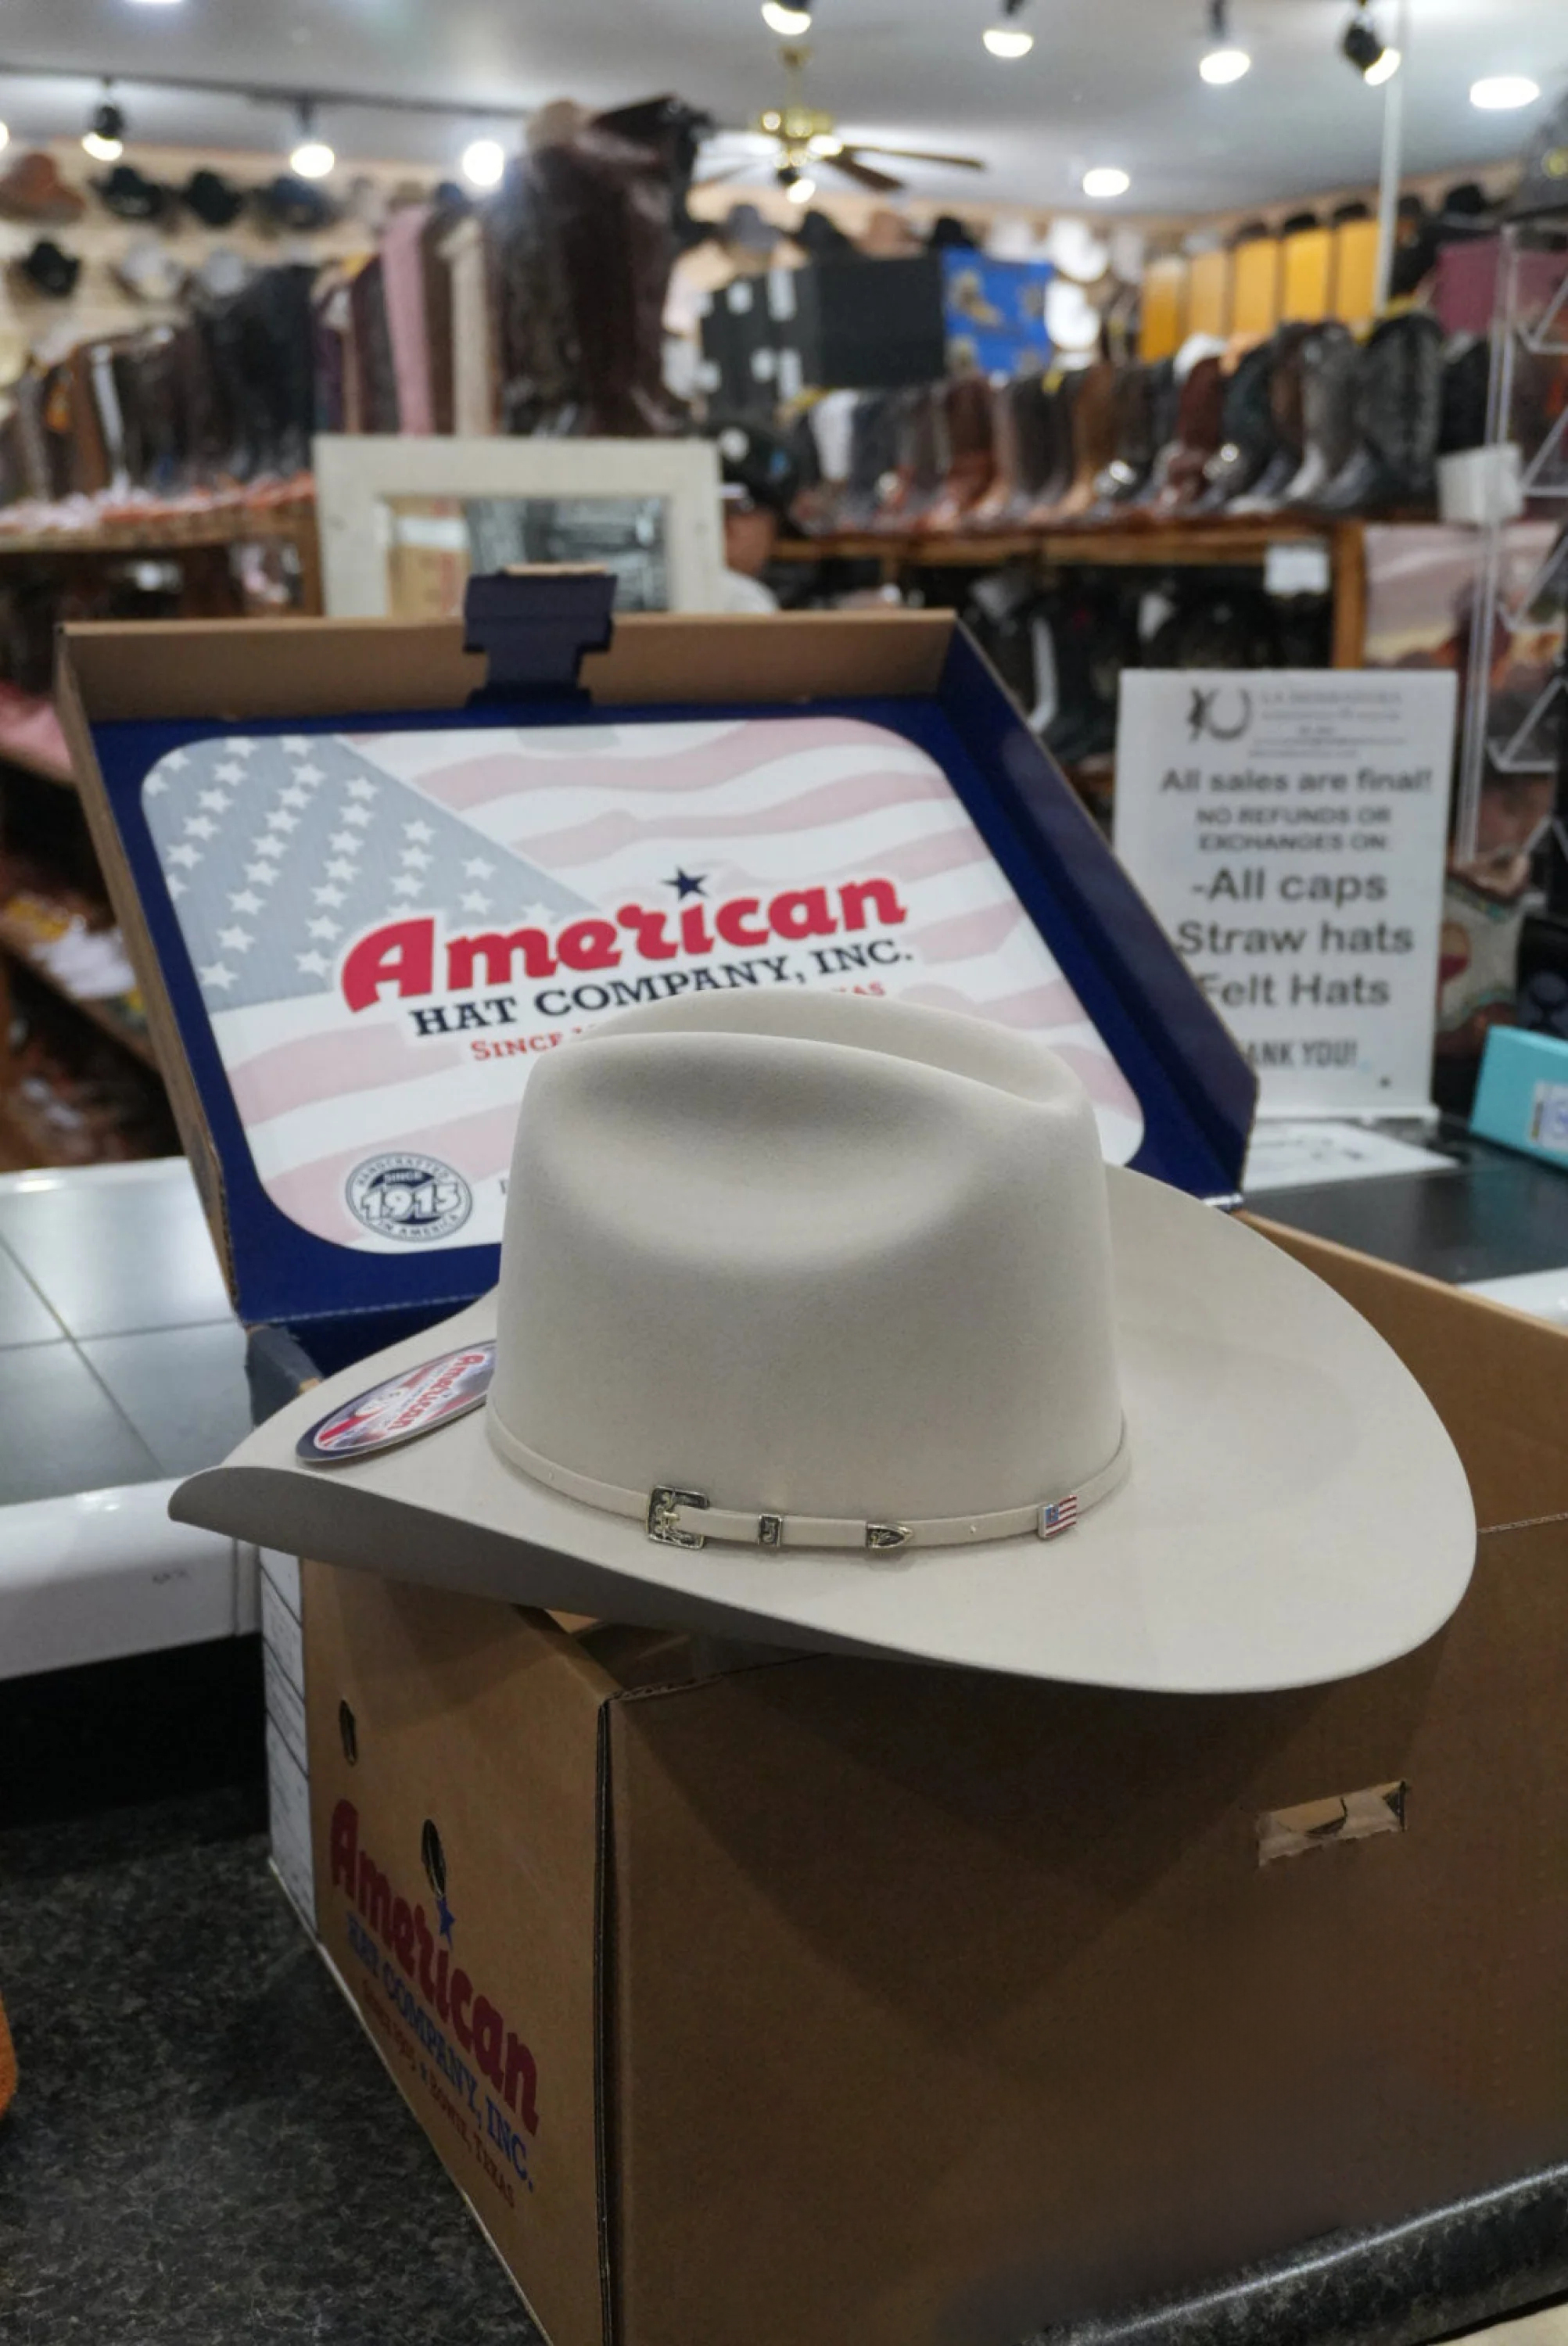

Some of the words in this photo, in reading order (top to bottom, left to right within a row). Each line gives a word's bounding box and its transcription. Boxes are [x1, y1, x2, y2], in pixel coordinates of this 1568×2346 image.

[1162, 769, 1200, 791] All
[1210, 769, 1289, 792] sales
[1298, 773, 1347, 792] are
[1197, 808, 1233, 824] NO
[1238, 808, 1351, 825] REFUNDS
[1358, 808, 1391, 825] OR
[1198, 833, 1344, 852] EXCHANGES
[1279, 873, 1387, 909] caps
[341, 877, 908, 1014] American
[1176, 920, 1307, 955] Straw
[1320, 919, 1414, 954] hats
[408, 999, 518, 1037] HAT
[533, 956, 807, 1017] COMPANY,
[818, 938, 913, 977] INC.
[1291, 972, 1390, 1006] Hats
[1301, 1039, 1358, 1067] YOU!
[361, 1182, 461, 1220] 1915
[330, 1798, 539, 2136] American
[383, 1960, 483, 2131] COMPANY,
[485, 2090, 533, 2194] INC.
